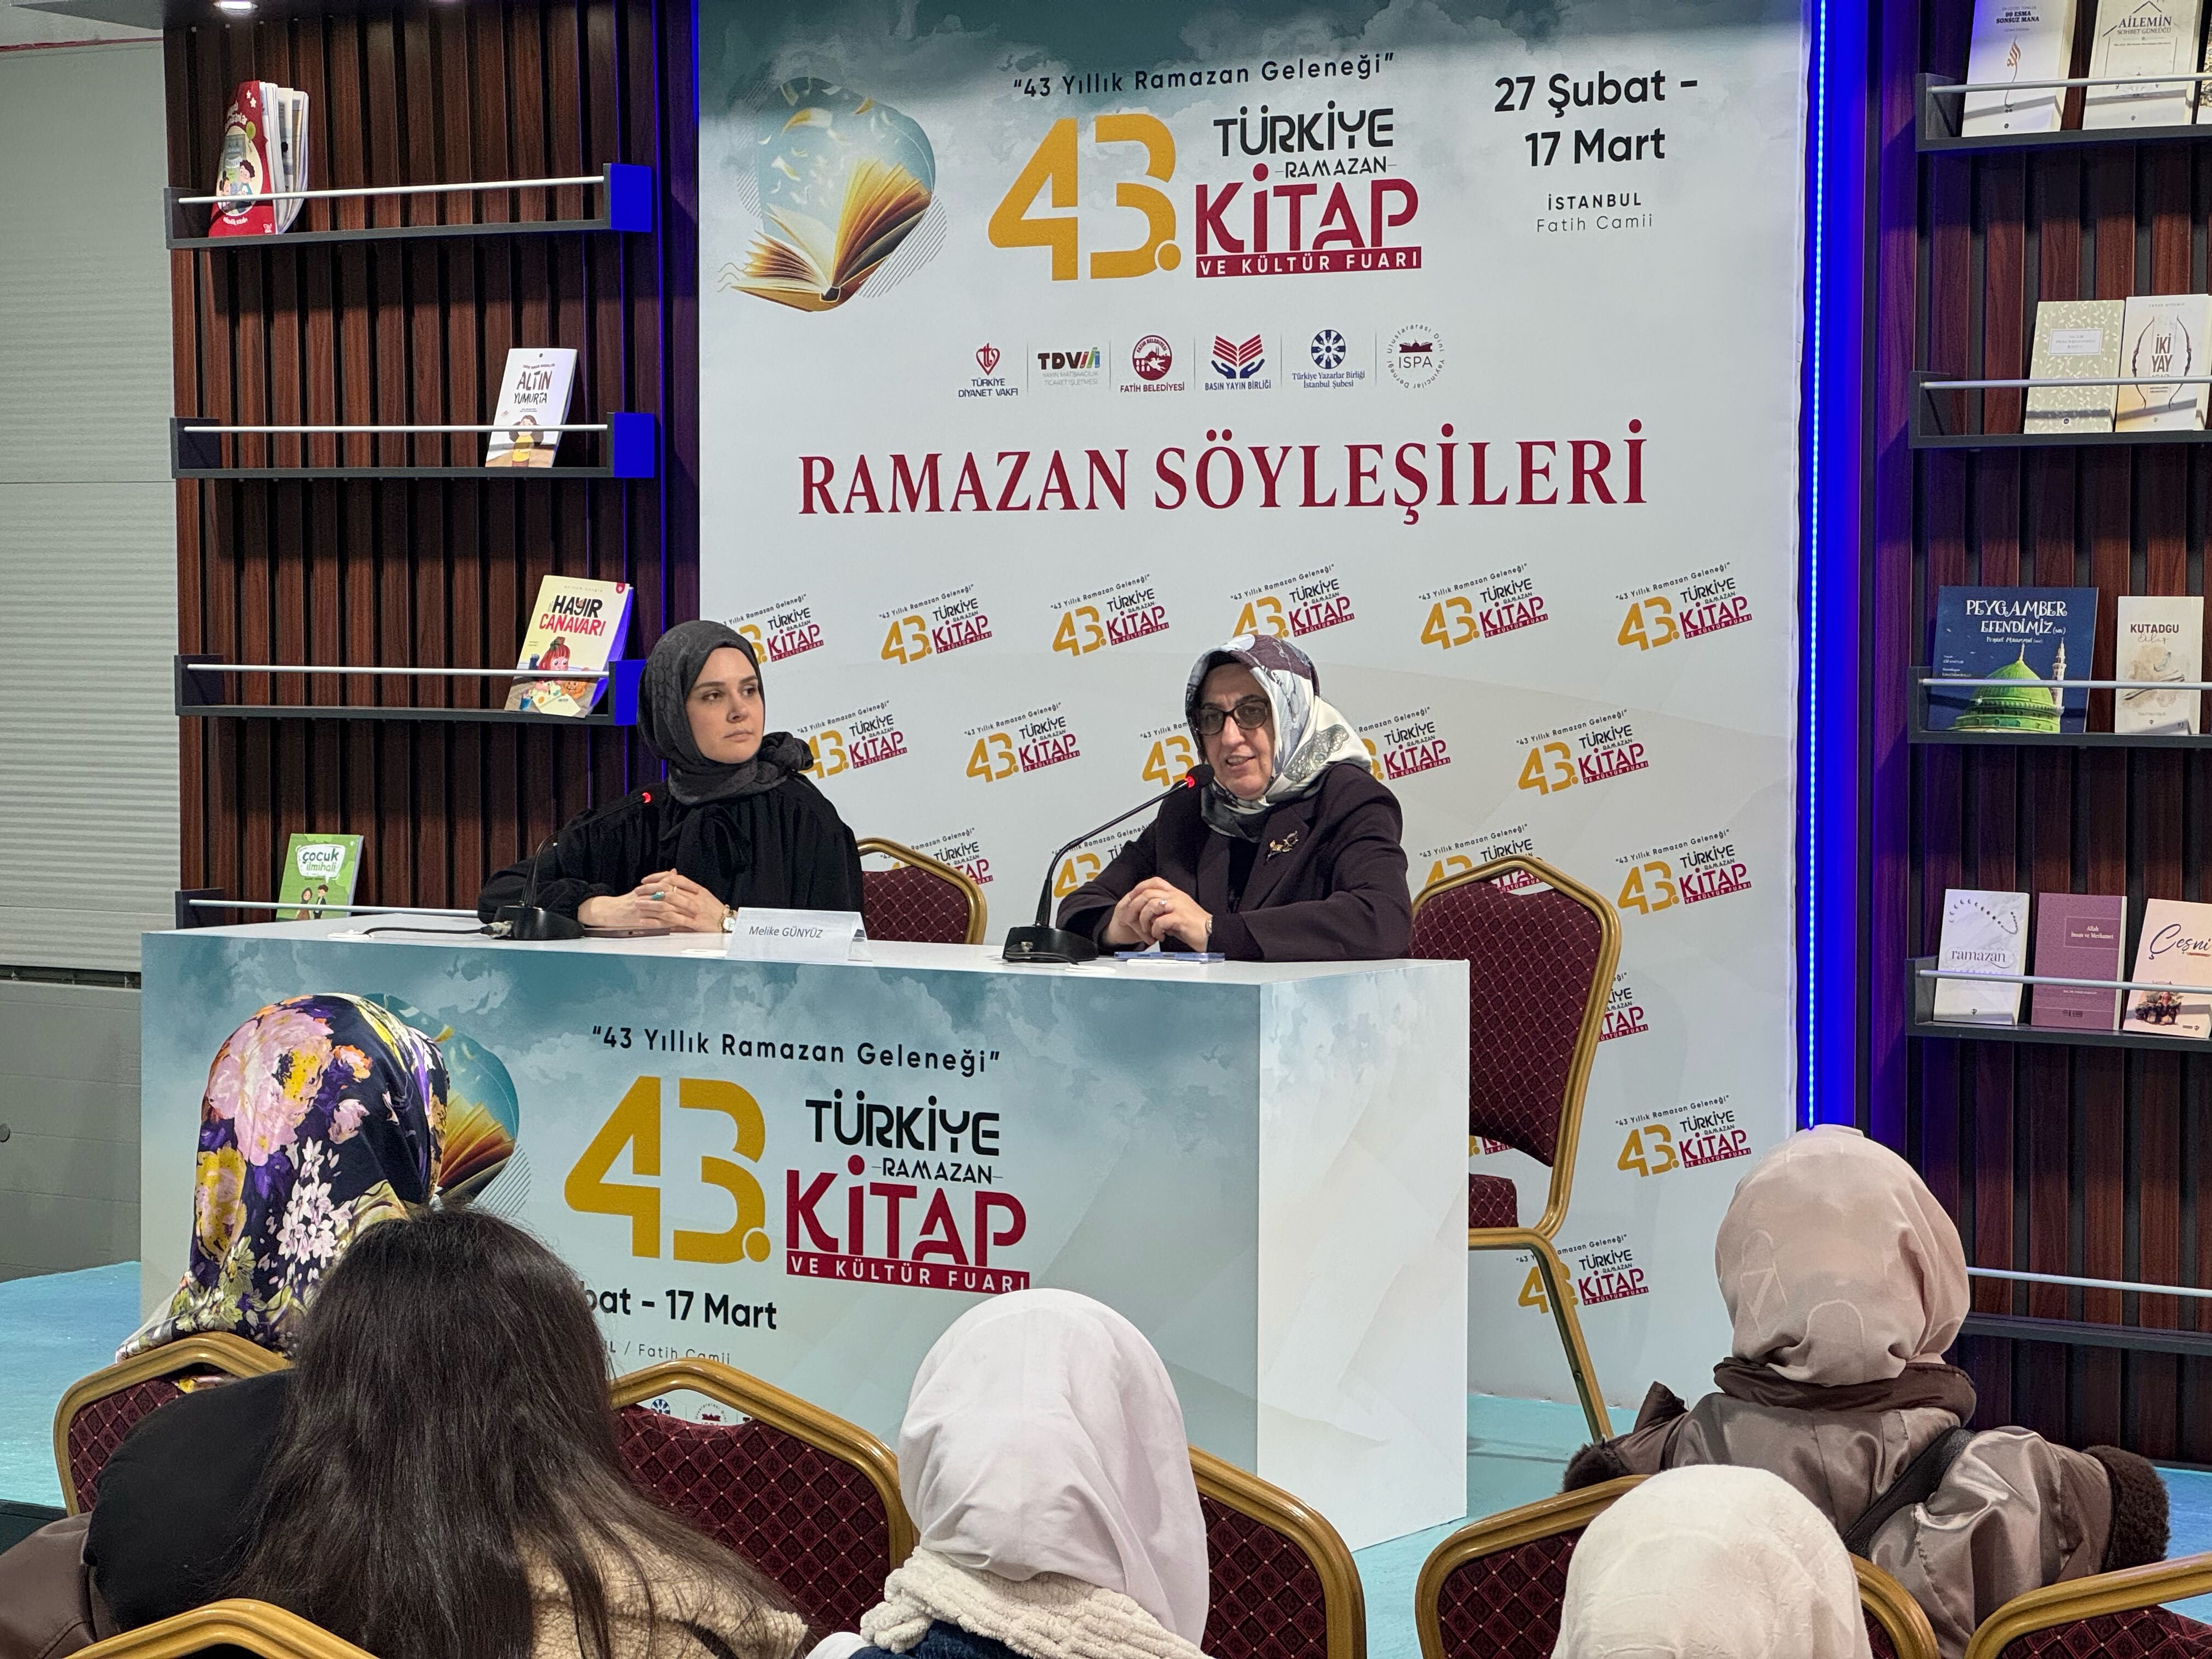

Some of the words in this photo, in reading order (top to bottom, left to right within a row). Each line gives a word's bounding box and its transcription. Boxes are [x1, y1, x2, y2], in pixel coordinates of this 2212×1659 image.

[2118, 14, 2172, 27] AİLEMİN
[1063, 72, 1122, 94] Yıllık
[1131, 65, 1248, 89] Ramazan
[1495, 76, 1536, 112] 27
[1548, 70, 1666, 118] Şubat
[1213, 100, 1394, 158] TÜRKİYE
[1525, 131, 1561, 166] 17
[1574, 128, 1666, 163] Mart
[1196, 163, 1418, 255] KİTAP
[1548, 193, 1641, 211] İSTANBUL
[1537, 217, 1585, 233] Fatih
[1596, 213, 1652, 229] Camii
[1200, 260, 1226, 275] VE
[1242, 253, 1330, 274] KÜLTÜR
[1346, 251, 1417, 269] FUARI
[2155, 333, 2172, 354] İKİ
[1399, 356, 1432, 369] ISPA
[2151, 354, 2173, 373] YAY
[516, 370, 553, 391] ALTIN
[970, 376, 1005, 387] TÜRKİYE
[1120, 382, 1141, 393] FATİH
[1143, 381, 1185, 392] BELEDİYESİ
[1205, 381, 1224, 391] BASIN
[1226, 381, 1246, 391] YAYIN
[1248, 379, 1271, 390] BİRLİĞİ
[1292, 372, 1317, 381] Türkiye
[1346, 371, 1365, 380] Birliği
[514, 392, 548, 405] YUMURTA
[958, 387, 992, 398] DİYANET
[799, 449, 1128, 514] RAMAZAN
[1154, 419, 1647, 525] SÖYLEŞİLERİ
[1289, 578, 1340, 603] TÜRKİYE
[1433, 587, 1452, 597] Yıllık
[1452, 577, 1488, 591] Ramazan
[1480, 578, 1533, 603] TÜRKİYE
[1630, 586, 1651, 597] Yıllık
[1650, 577, 1689, 591] Ramazan
[1680, 577, 1736, 603] TÜRKİYE
[551, 595, 603, 618] HAYIR
[932, 597, 979, 622] TÜRKİYE
[1107, 588, 1155, 612] TÜRKİYE
[1966, 600, 2068, 619] PEYGAMBER
[539, 613, 606, 636] CANAVARI
[767, 607, 811, 630] TÜRKİYE
[1106, 606, 1166, 640] KİTAP
[1289, 596, 1351, 631] KİTAP
[1479, 596, 1544, 631] KİTAP
[1679, 596, 1748, 633] KİTAP
[932, 615, 989, 648] KİTAP
[1980, 618, 2053, 635] EFENDİMİZ
[2130, 624, 2179, 634] KUTADGU
[767, 624, 821, 656] KİTAP
[849, 713, 894, 737] TÜRKİYE
[1019, 715, 1066, 740] TÜRKİYE
[1384, 721, 1436, 746] TÜRKİYE
[1531, 732, 1550, 742] Yıllık
[1550, 723, 1587, 736] Ramazan
[1579, 724, 1633, 749] TÜRKİYE
[849, 731, 904, 763] KİTAP
[1018, 733, 1076, 766] KİTAP
[1384, 740, 1447, 774] KİTAP
[1578, 743, 1645, 778] KİTAP
[302, 848, 339, 864] çocuk
[934, 841, 980, 864] TÜRKİYE
[1480, 838, 1533, 863] TÜRKİYE
[1630, 851, 1651, 861] Yıllık
[1650, 842, 1688, 855] Ramazan
[1680, 844, 1736, 869] TÜRKİYE
[306, 861, 336, 872] ilmihali
[1679, 863, 1747, 898] KİTAP
[749, 926, 780, 936] Melike
[782, 926, 823, 938] GÜNYÜZ
[2149, 923, 2211, 960] Çeşni
[1952, 950, 2006, 962] ramazan
[644, 1029, 709, 1053] Yıllık
[722, 1034, 843, 1063] Ramazan
[805, 1088, 1000, 1156] TÜRKİYE
[1630, 1114, 1650, 1124] Yıllık
[1650, 1106, 1688, 1119] Ramazan
[1679, 1110, 1736, 1133] TÜRKİYE
[1679, 1130, 1747, 1162] KİTAP
[787, 1155, 1026, 1266] KİTAP
[1578, 1249, 1633, 1271] TÜRKİYE
[791, 1256, 818, 1274] VE
[836, 1259, 930, 1285] KÜLTÜR
[949, 1271, 1024, 1291] FUARI
[1578, 1268, 1645, 1299] KİTAP
[665, 1290, 694, 1321] 17
[704, 1293, 777, 1330] Mart
[639, 1344, 678, 1359] Fatih
